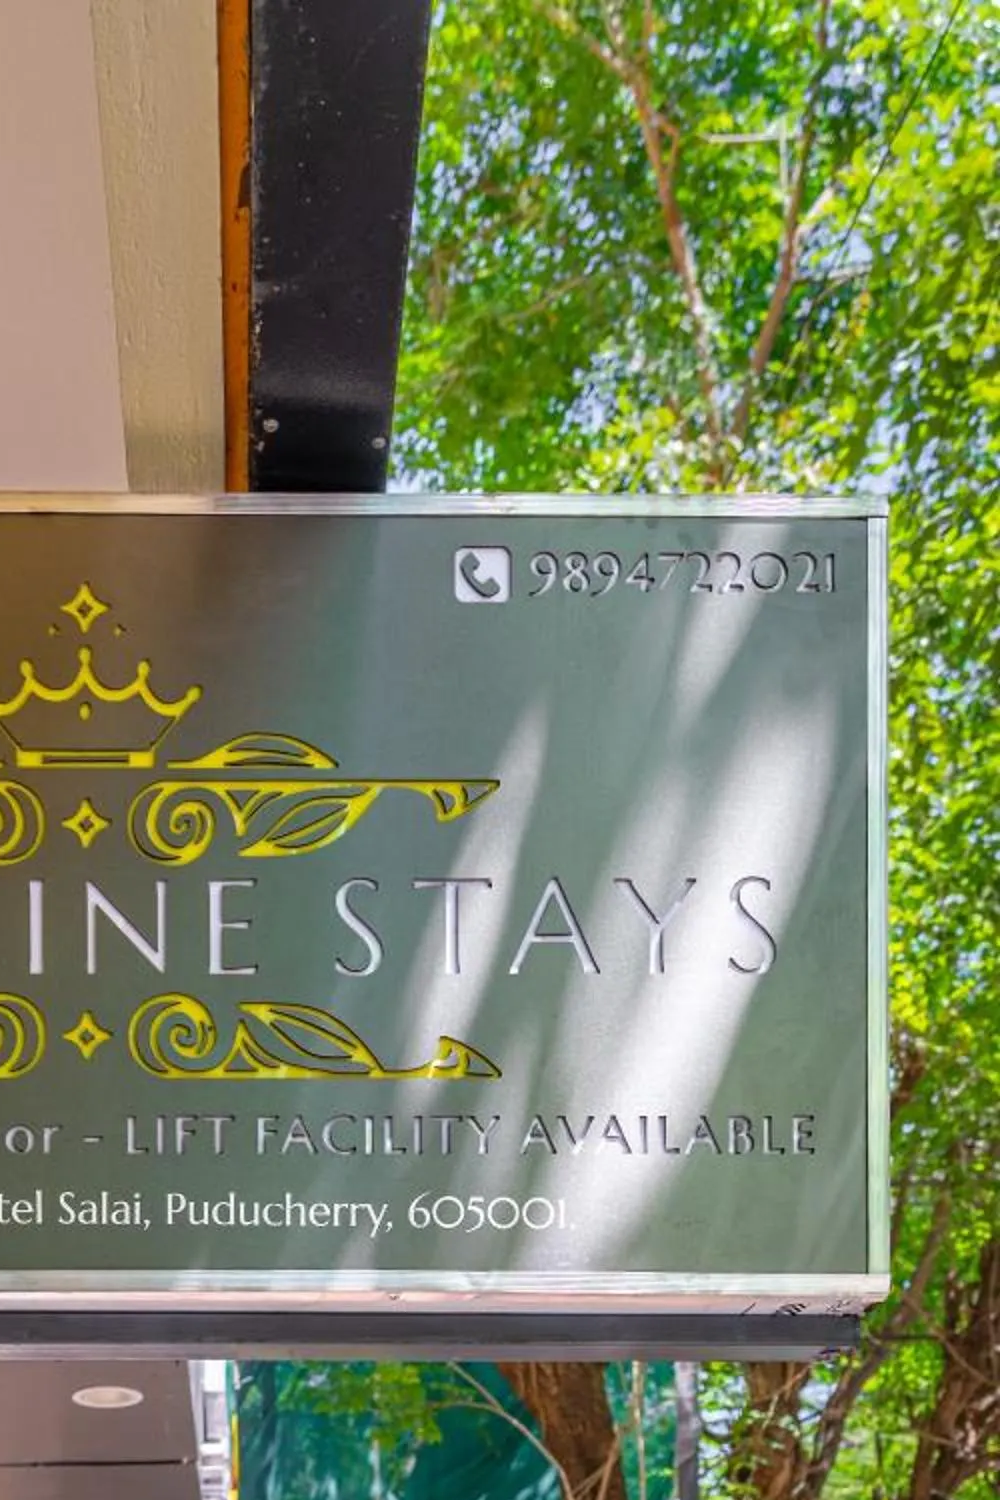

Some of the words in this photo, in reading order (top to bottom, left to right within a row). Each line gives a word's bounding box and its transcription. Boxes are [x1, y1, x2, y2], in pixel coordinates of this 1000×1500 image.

[529, 551, 836, 597] 9894722021
[333, 876, 778, 978] STAYS
[126, 1114, 235, 1156] LIFT
[256, 1114, 501, 1157] FACILITY
[519, 1113, 817, 1156] AVAILABLE
[58, 1192, 151, 1230] Salai,
[166, 1193, 393, 1236] Puducherry,
